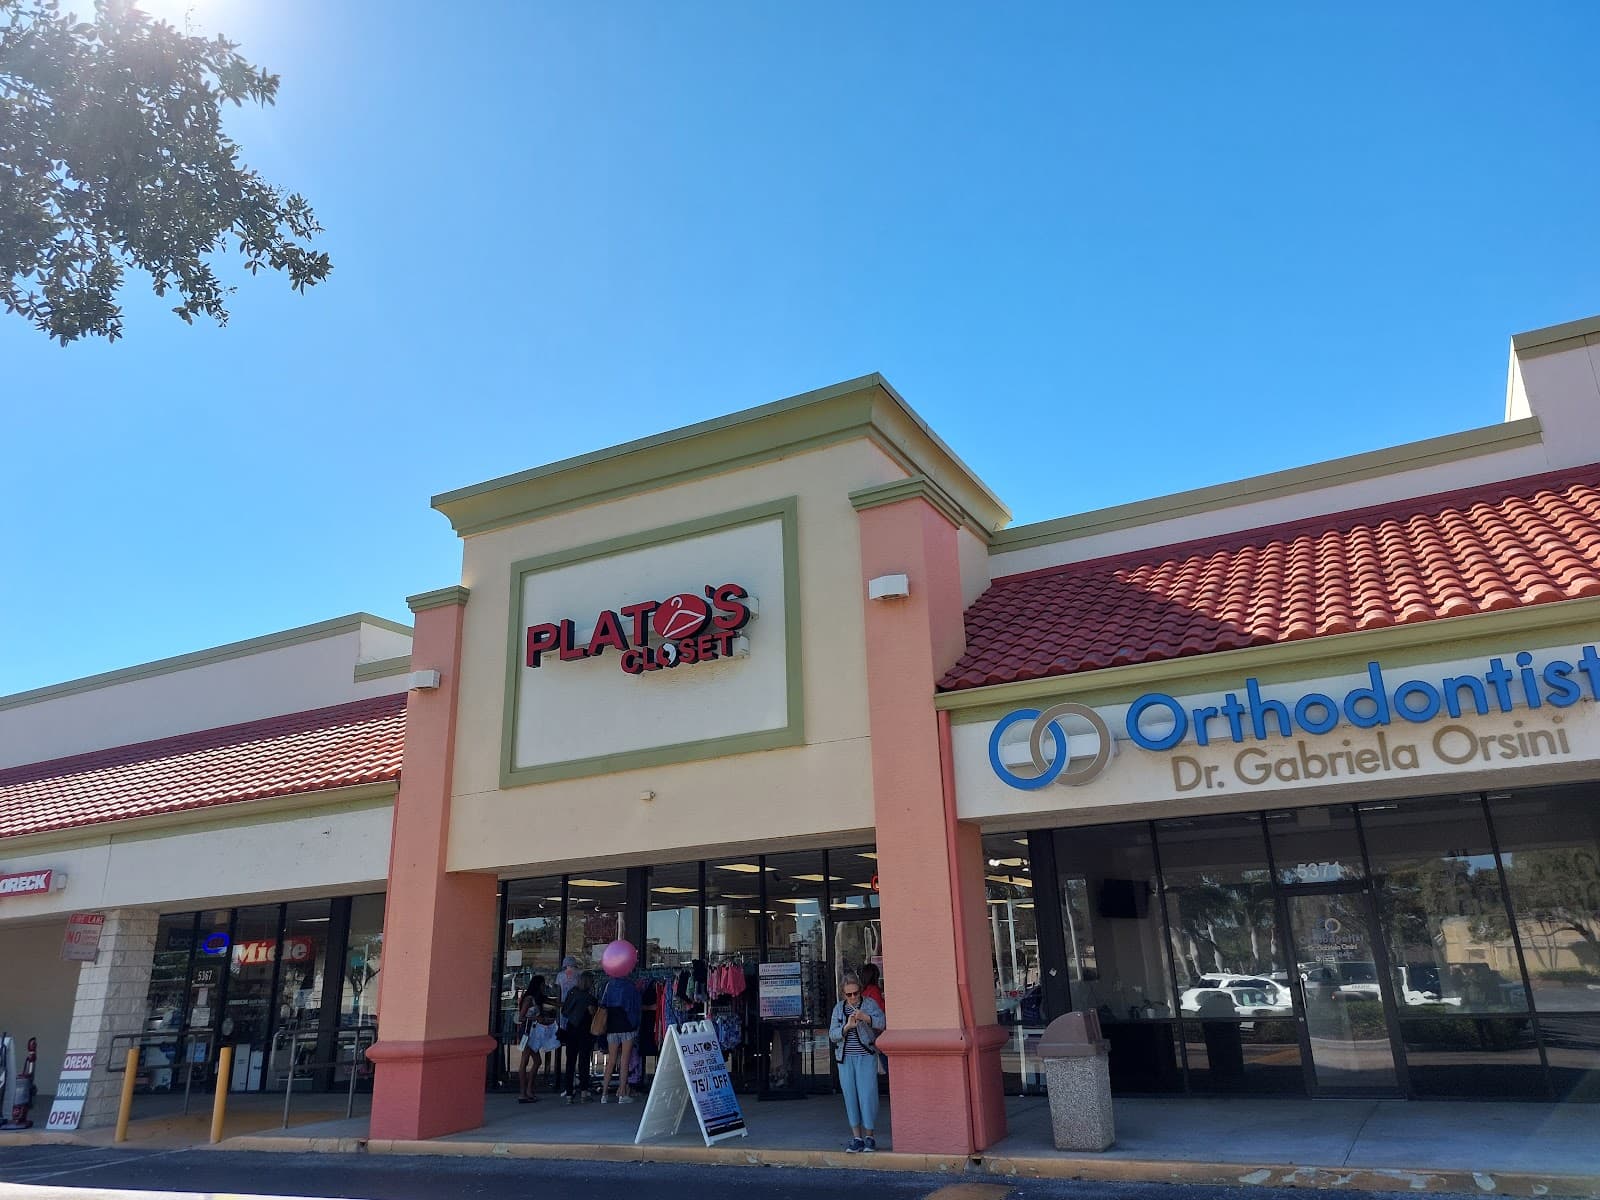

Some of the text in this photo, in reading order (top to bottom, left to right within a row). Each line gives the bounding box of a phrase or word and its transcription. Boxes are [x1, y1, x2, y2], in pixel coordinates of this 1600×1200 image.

[526, 583, 749, 668] PLATO'S
[620, 631, 736, 674] CLOSET
[1126, 645, 1600, 752] Orthodontist
[1171, 715, 1570, 792] Dr. Gabriela Orsini
[0, 871, 50, 893] ORECK
[65, 930, 81, 944] NO
[64, 1055, 94, 1069] ORECK
[692, 1074, 728, 1093] 75% OFF
[49, 1111, 80, 1125] OPEN
